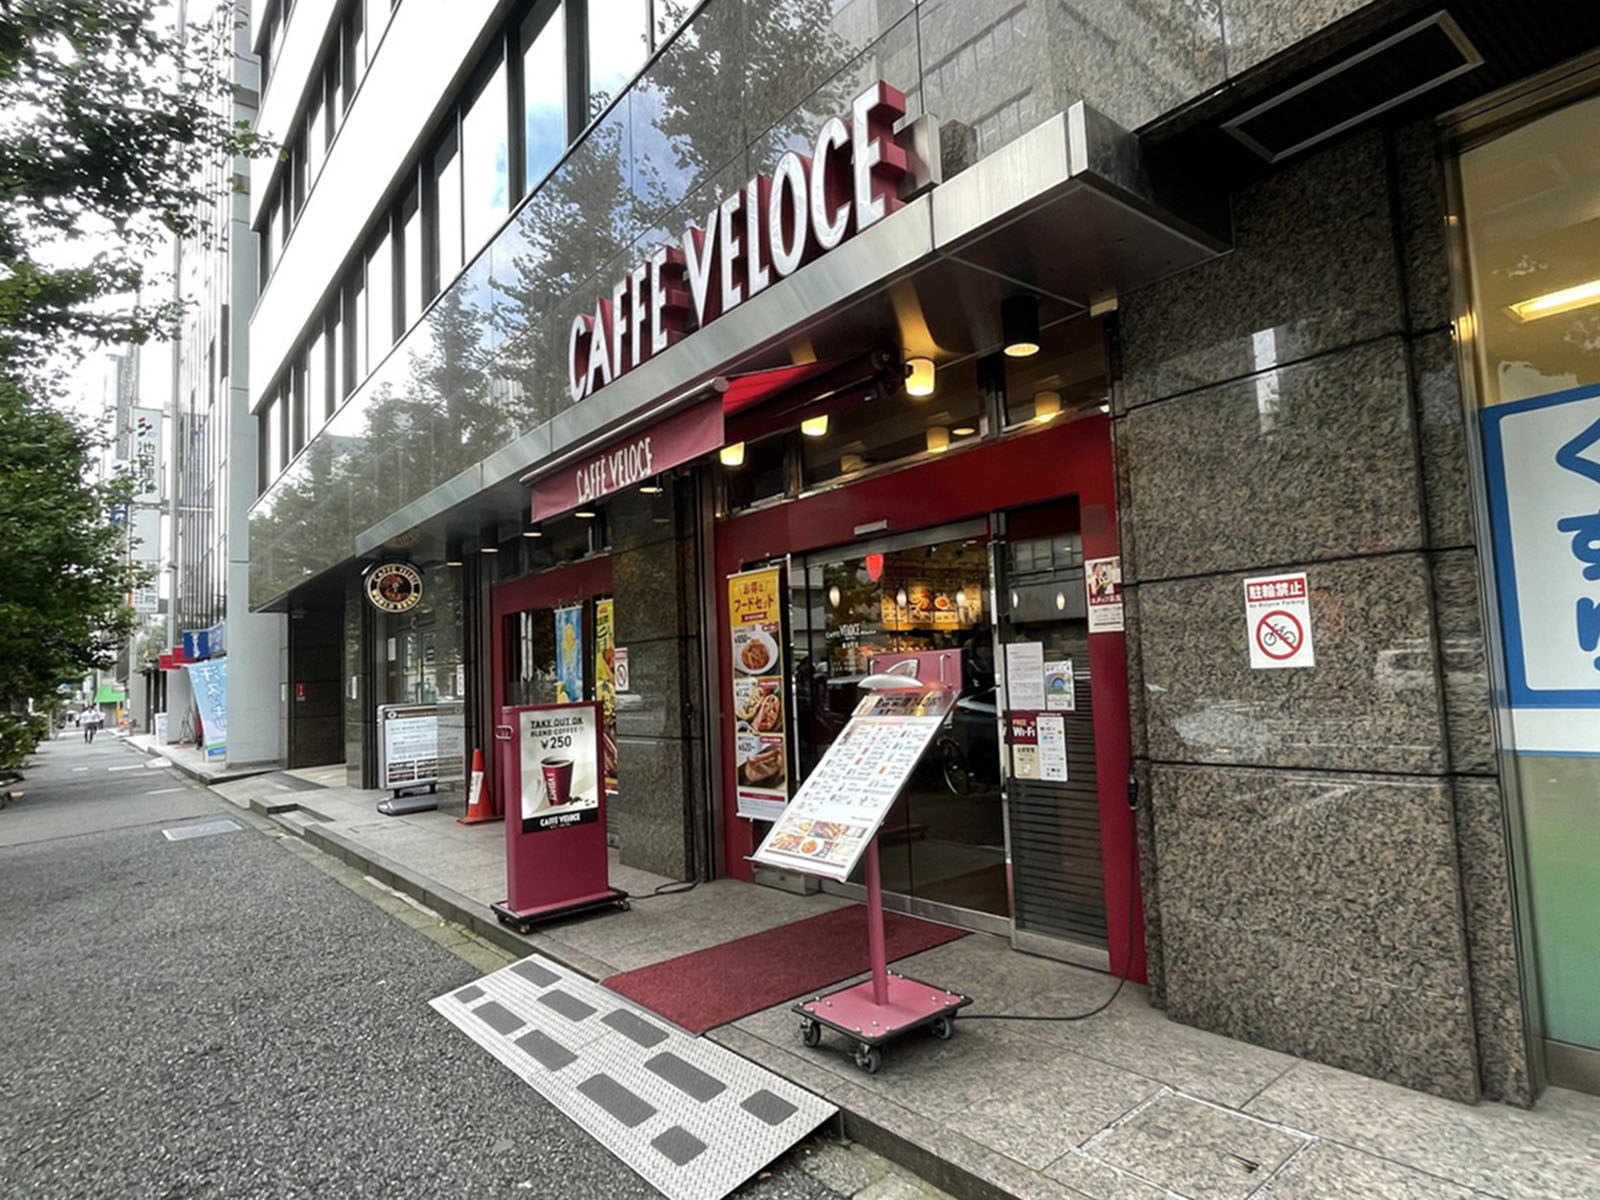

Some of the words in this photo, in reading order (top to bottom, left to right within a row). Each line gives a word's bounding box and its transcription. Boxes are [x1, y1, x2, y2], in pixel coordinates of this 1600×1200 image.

[683, 79, 893, 329] VELOCE
[608, 437, 652, 489] VELOCE
[1248, 580, 1304, 600] 駐輪禁止
[733, 593, 775, 613] フードセット
[530, 720, 551, 729] TAKE
[553, 718, 570, 727] OUT
[572, 716, 584, 725] OK
[530, 729, 552, 738] BLEND
[553, 727, 578, 736] COFFEE
[1012, 726, 1036, 737] Wi-Fi
[540, 735, 572, 750] ¥250
